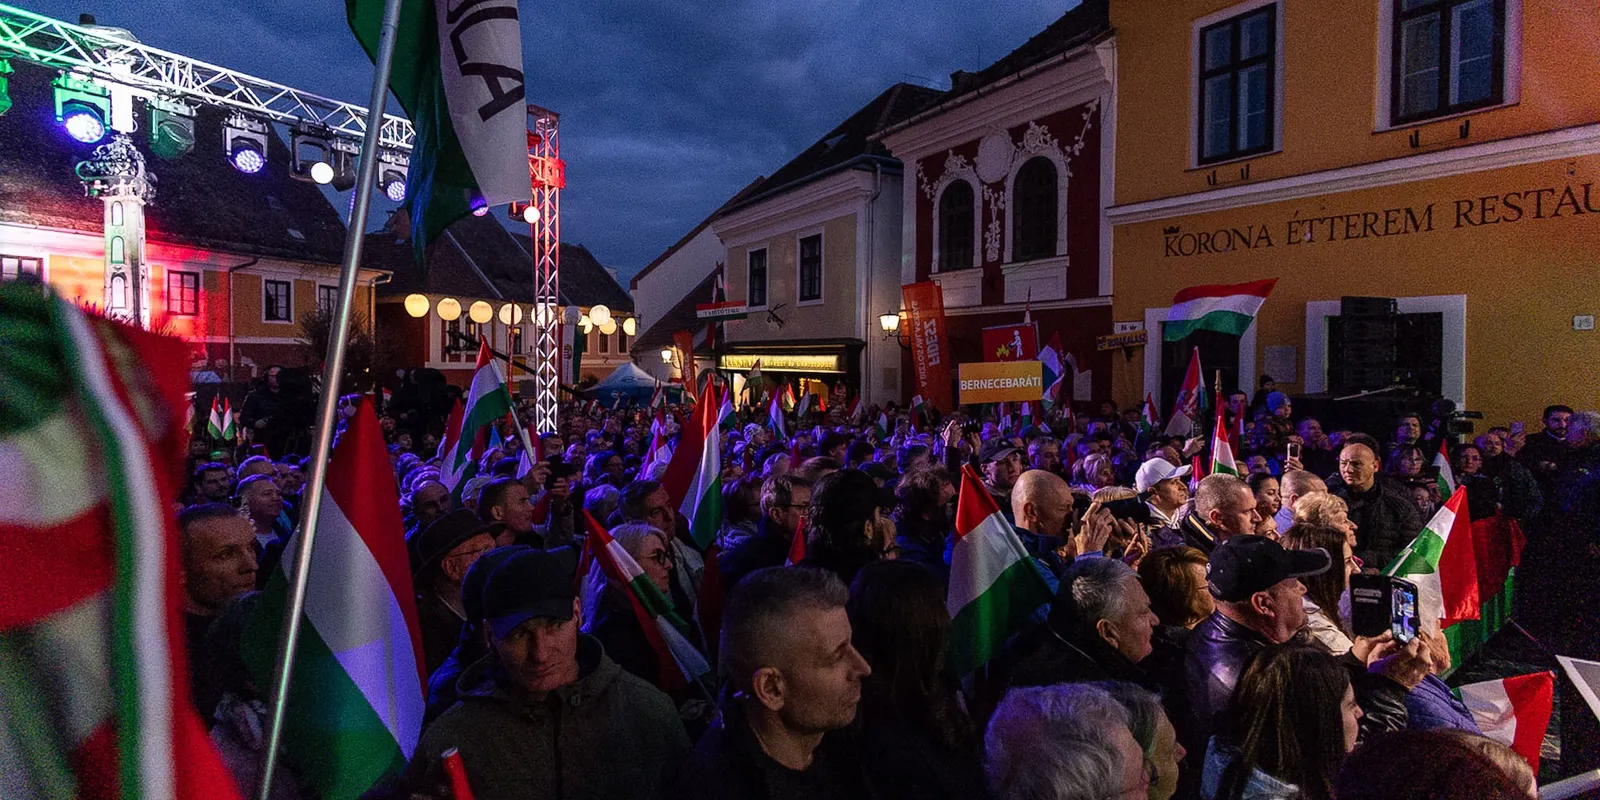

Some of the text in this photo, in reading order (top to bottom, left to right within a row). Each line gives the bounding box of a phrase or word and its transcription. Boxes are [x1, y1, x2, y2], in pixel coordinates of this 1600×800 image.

[1164, 225, 1274, 258] KORONA
[1286, 203, 1435, 245] ÉTTEREM
[961, 375, 1041, 390] BERNECEBARÁTI
